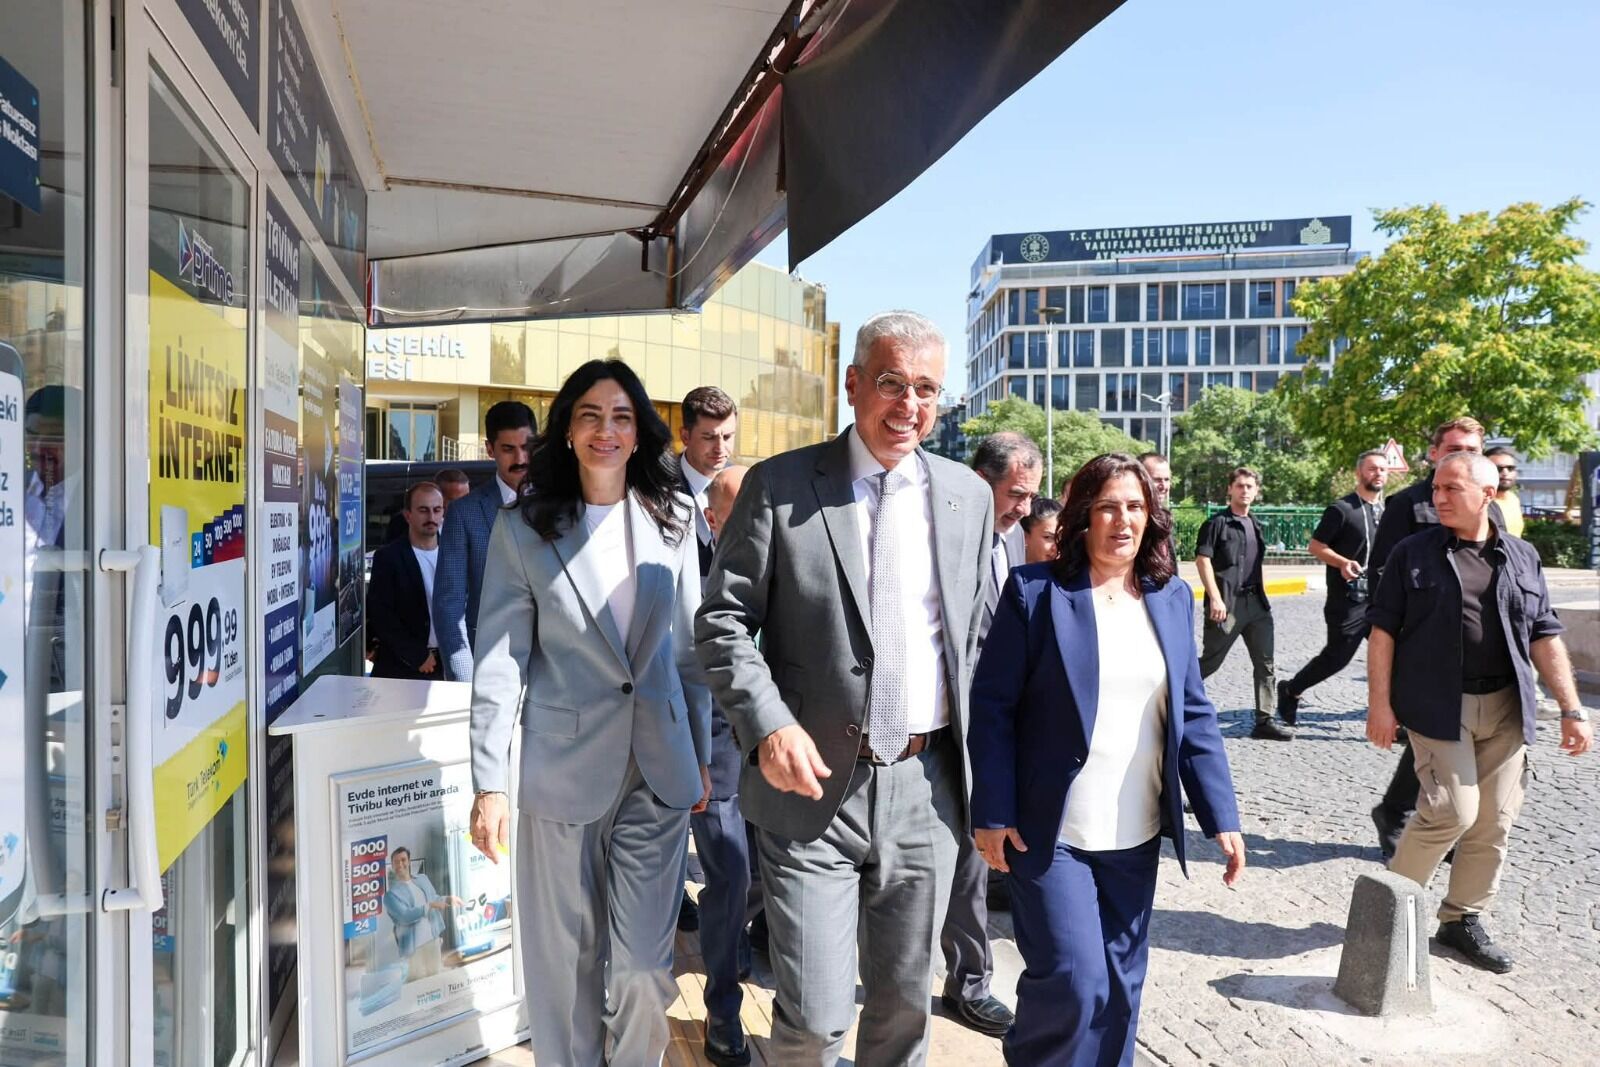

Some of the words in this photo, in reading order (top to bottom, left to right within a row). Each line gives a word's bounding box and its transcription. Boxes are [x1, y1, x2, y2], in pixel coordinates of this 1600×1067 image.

[1069, 231, 1093, 241] T.C.
[1095, 228, 1139, 240] KÜLTÜR
[1141, 227, 1156, 238] VE
[1158, 224, 1203, 237] TURİZM
[1206, 220, 1273, 235] BAKANLIĞI
[1084, 240, 1142, 251] VAKIFLAR
[1145, 236, 1182, 248] GENEL
[158, 399, 242, 484] İNTERNET
[347, 788, 376, 803] Evde
[377, 779, 420, 797] internet
[421, 777, 434, 788] ve
[347, 800, 383, 815] Tivibu
[384, 792, 411, 807] keyfi
[413, 789, 428, 801] bir
[429, 784, 460, 798] arada
[351, 840, 386, 857] 1000
[352, 861, 381, 878] 500
[352, 880, 380, 897] 200
[352, 898, 379, 914] 100
[355, 918, 370, 931] 24
